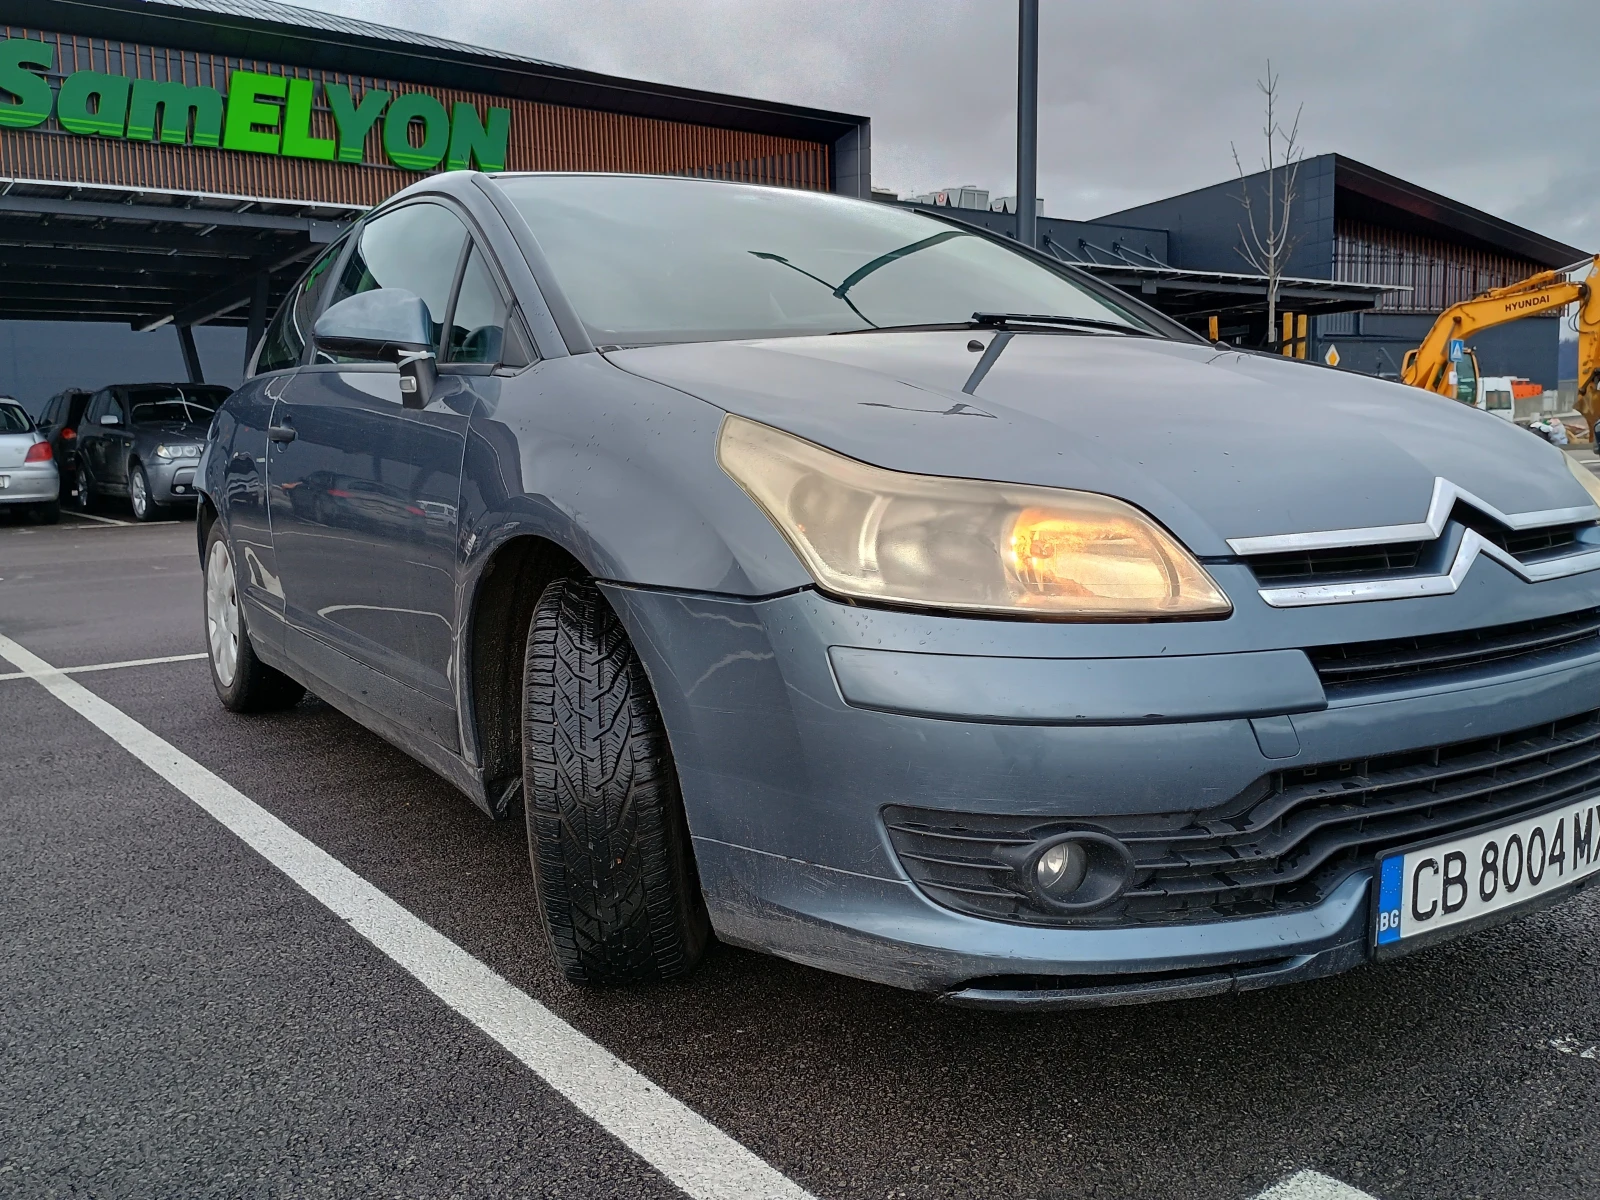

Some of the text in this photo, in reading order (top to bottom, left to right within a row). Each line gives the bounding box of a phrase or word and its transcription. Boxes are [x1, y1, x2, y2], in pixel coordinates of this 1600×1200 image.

[0, 38, 511, 173] SamELYON
[1504, 294, 1550, 312] HYUNDAI
[1411, 850, 1468, 922] CB
[1478, 817, 1566, 902] 8004
[1379, 909, 1399, 932] BG
